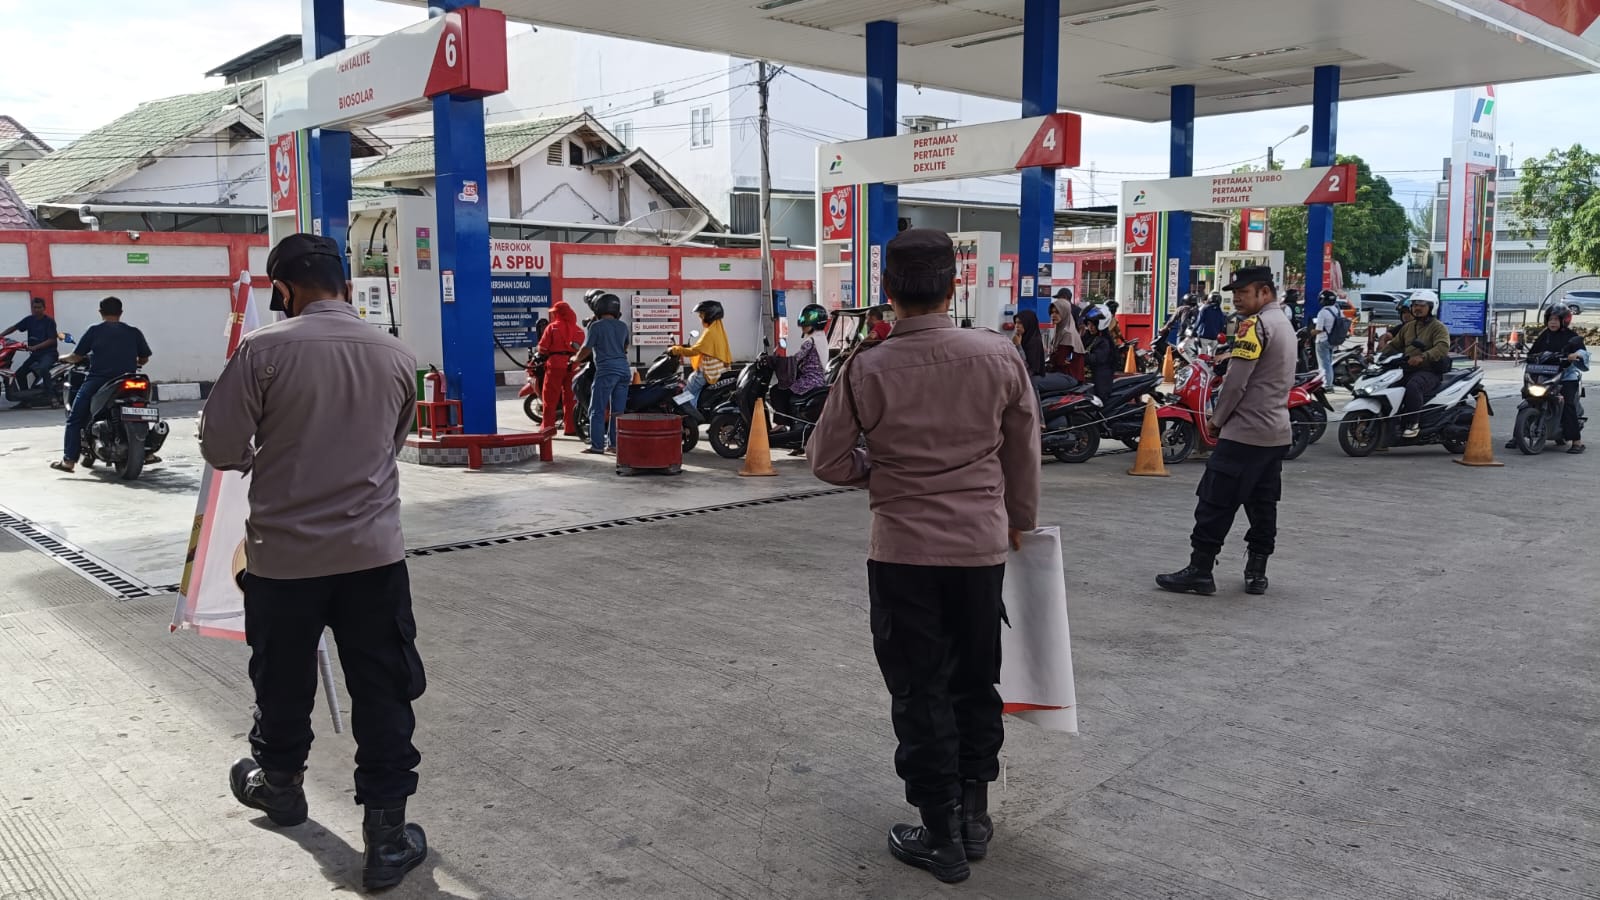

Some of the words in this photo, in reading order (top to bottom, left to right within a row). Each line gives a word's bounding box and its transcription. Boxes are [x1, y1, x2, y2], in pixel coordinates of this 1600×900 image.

[446, 33, 457, 67] 6
[338, 88, 374, 109] BIOSOLAR
[914, 134, 958, 148] PERTAMAX
[1043, 128, 1056, 151] 4
[914, 147, 955, 160] PERTALITE
[914, 161, 947, 172] DEXLITE
[1213, 176, 1253, 186] PERTAMAX
[1255, 174, 1282, 183] TURBO
[1328, 175, 1340, 191] 2
[1212, 186, 1253, 195] PERTAMAX
[1212, 195, 1250, 203] PERTALITE
[495, 242, 531, 251] MEROKOK
[506, 255, 544, 270] SPBU
[515, 295, 548, 304] LINGKUNGAN
